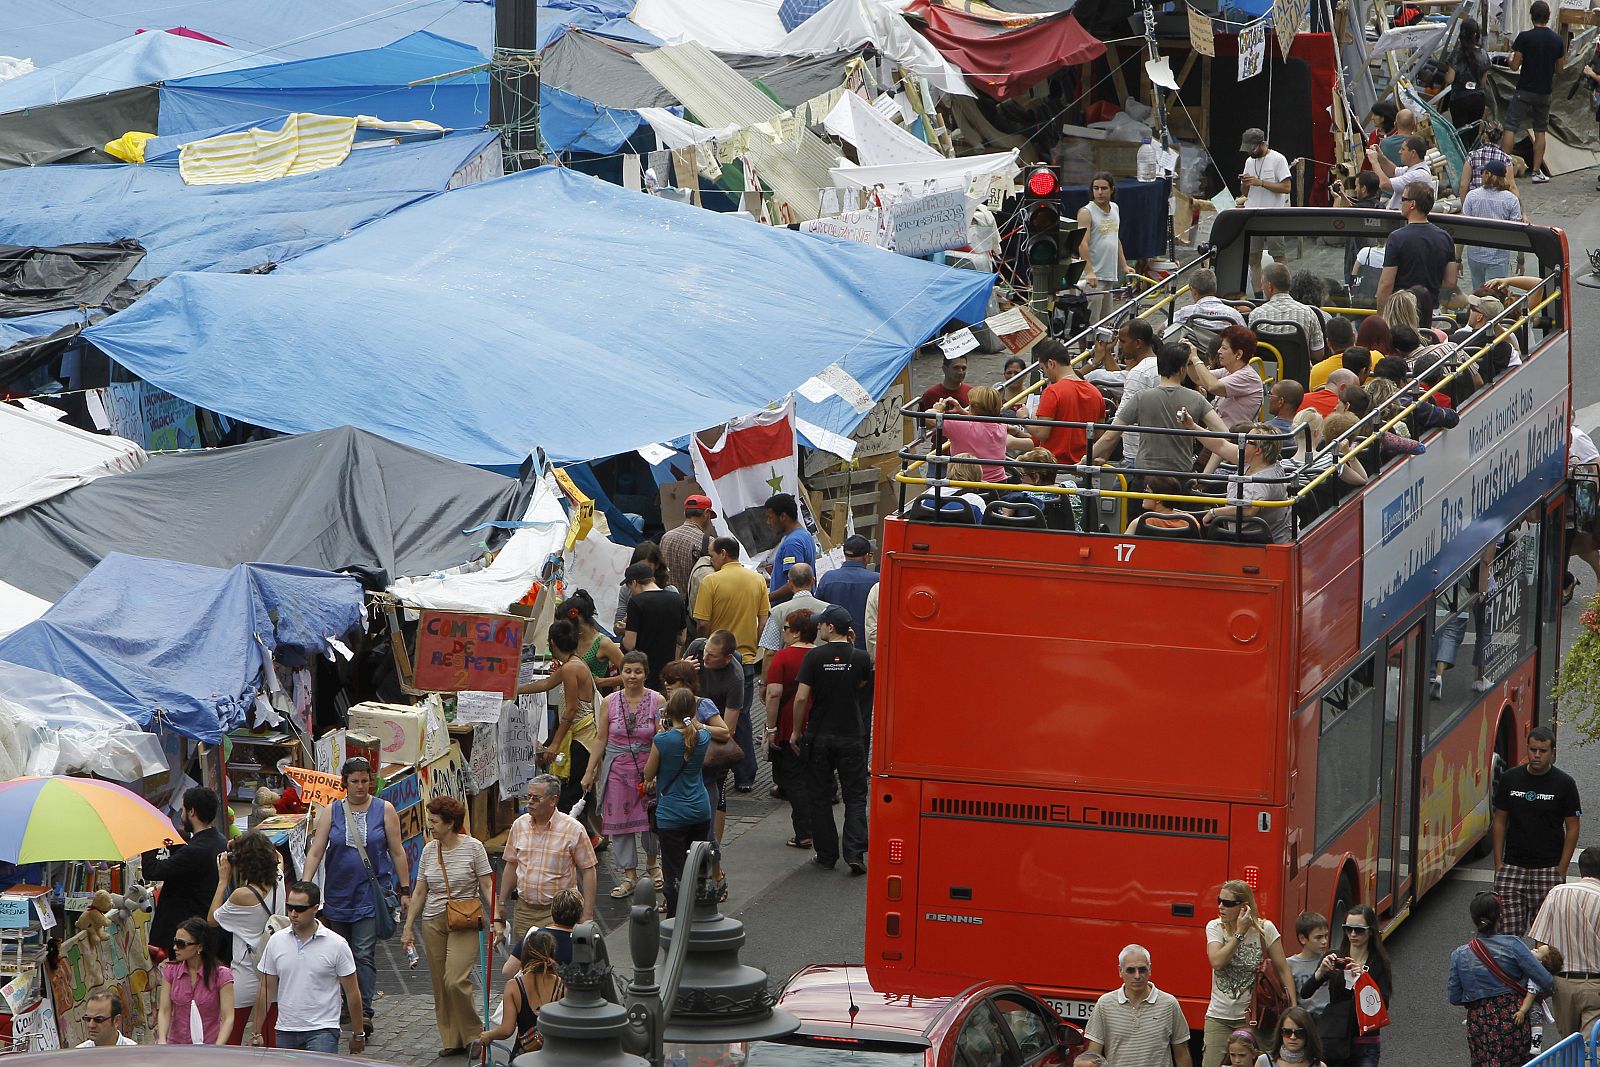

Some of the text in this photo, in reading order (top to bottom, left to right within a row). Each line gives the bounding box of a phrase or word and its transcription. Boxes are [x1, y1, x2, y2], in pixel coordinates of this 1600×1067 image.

[1469, 387, 1533, 458] Madrid tourist bus
[1441, 400, 1566, 545] Bus turístico Madrid
[1404, 476, 1425, 530] EMT
[1113, 543, 1137, 562] 17
[452, 640, 475, 656] DE
[431, 651, 508, 675] RESPETO
[452, 669, 470, 690] 2
[1536, 793, 1555, 801] STREET
[1050, 804, 1099, 825] ELC
[925, 912, 984, 925] DENNIS
